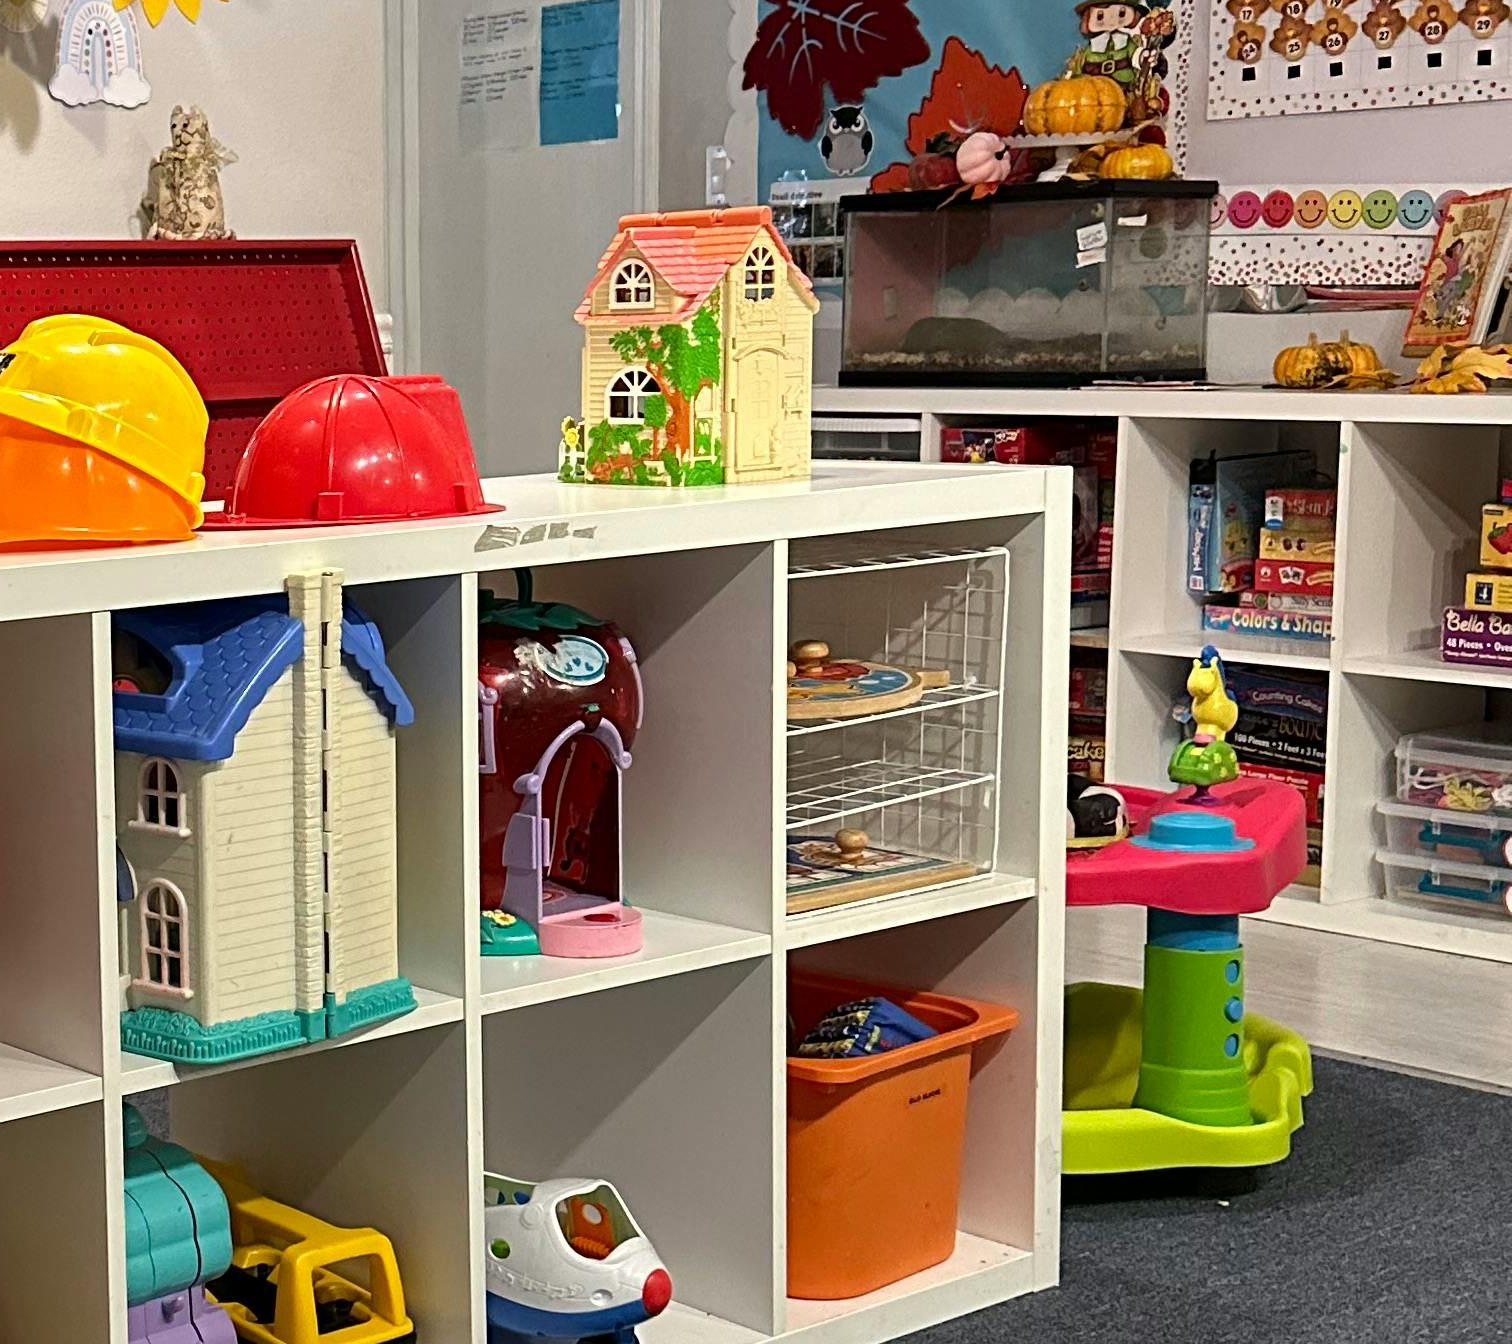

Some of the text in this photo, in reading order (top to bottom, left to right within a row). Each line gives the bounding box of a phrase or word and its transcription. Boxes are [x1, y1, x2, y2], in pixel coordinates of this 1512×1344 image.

[1242, 10, 1252, 20] 17
[1288, 3, 1300, 15] 18
[1244, 19, 1490, 58] 24 25 26 27 28 29
[1231, 609, 1277, 631] Colors
[1281, 615, 1290, 630] &
[1447, 609, 1484, 633] Bella
[1447, 638, 1456, 647] 48
[1458, 638, 1484, 650] Pieces
[1252, 691, 1293, 704] Counting
[1277, 742, 1283, 751] 2
[1284, 742, 1300, 753] Feet
[1306, 747, 1312, 756] 3
